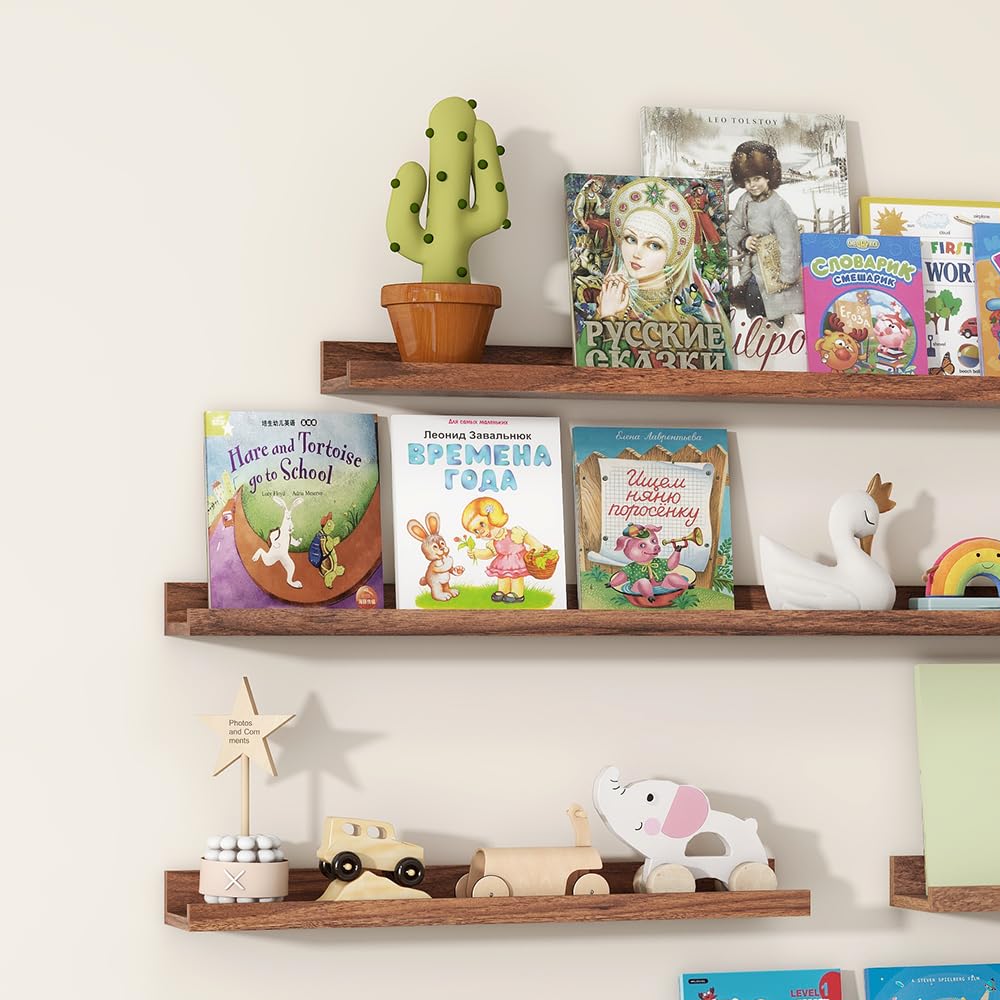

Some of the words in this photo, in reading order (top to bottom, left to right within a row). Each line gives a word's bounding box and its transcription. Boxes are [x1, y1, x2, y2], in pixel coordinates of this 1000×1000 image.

[708, 116, 727, 124] LEO
[731, 117, 778, 126] TOLSTOY
[930, 241, 973, 255] FIRST
[925, 261, 976, 284] WOR
[833, 273, 896, 287] СМЕШАРИК
[584, 319, 726, 351] РУССКИЕ
[423, 430, 467, 441] Леонид
[469, 430, 532, 440] Завальнюк
[615, 431, 641, 441] Елена
[228, 444, 268, 474] Hare
[271, 438, 295, 455] and
[298, 431, 362, 468] Tortoise
[407, 443, 553, 467] ВРЕМЕНА
[249, 475, 263, 494] go
[266, 468, 278, 482] to
[280, 457, 334, 485] School
[444, 468, 518, 492] ГОДА
[626, 468, 687, 491] Ищем
[625, 490, 682, 504] няню
[608, 502, 701, 527] поросёнку
[228, 719, 253, 727] Photos
[228, 728, 242, 736] and
[244, 728, 261, 736] Com
[790, 989, 820, 998] LEVEL
